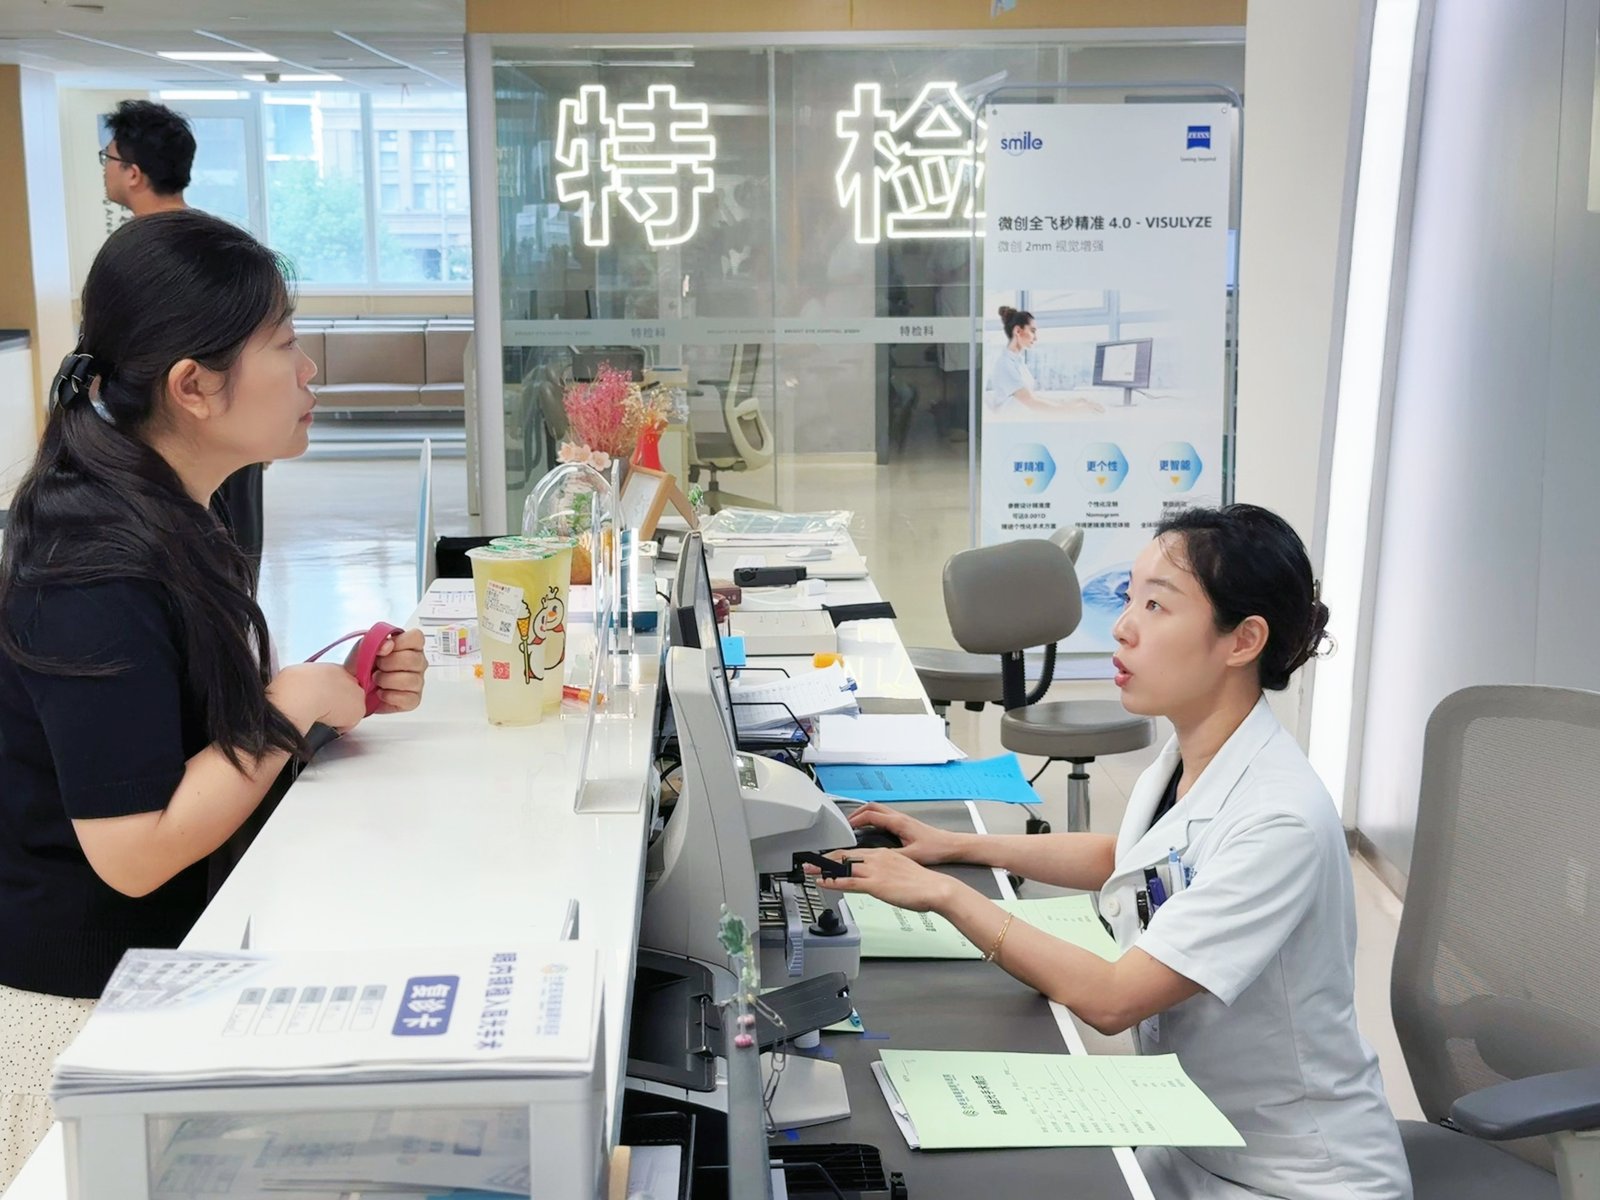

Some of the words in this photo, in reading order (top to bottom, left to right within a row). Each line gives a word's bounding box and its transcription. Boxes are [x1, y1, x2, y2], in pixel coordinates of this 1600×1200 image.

[1000, 131, 1043, 150] smile
[998, 216, 1105, 231] 微创全飞秒精准
[1109, 216, 1131, 229] 4.0
[1145, 216, 1213, 229] VISULYZE
[998, 240, 1022, 252] 微创
[1025, 241, 1052, 252] 2mm
[1055, 240, 1104, 252] 视觉增强
[631, 327, 666, 338] 特检科
[899, 325, 934, 337] 特检科
[1013, 461, 1045, 473] 更精准
[1086, 460, 1119, 472] 更个性
[1159, 459, 1191, 471] 更智能
[402, 983, 451, 1029] 复诊卡
